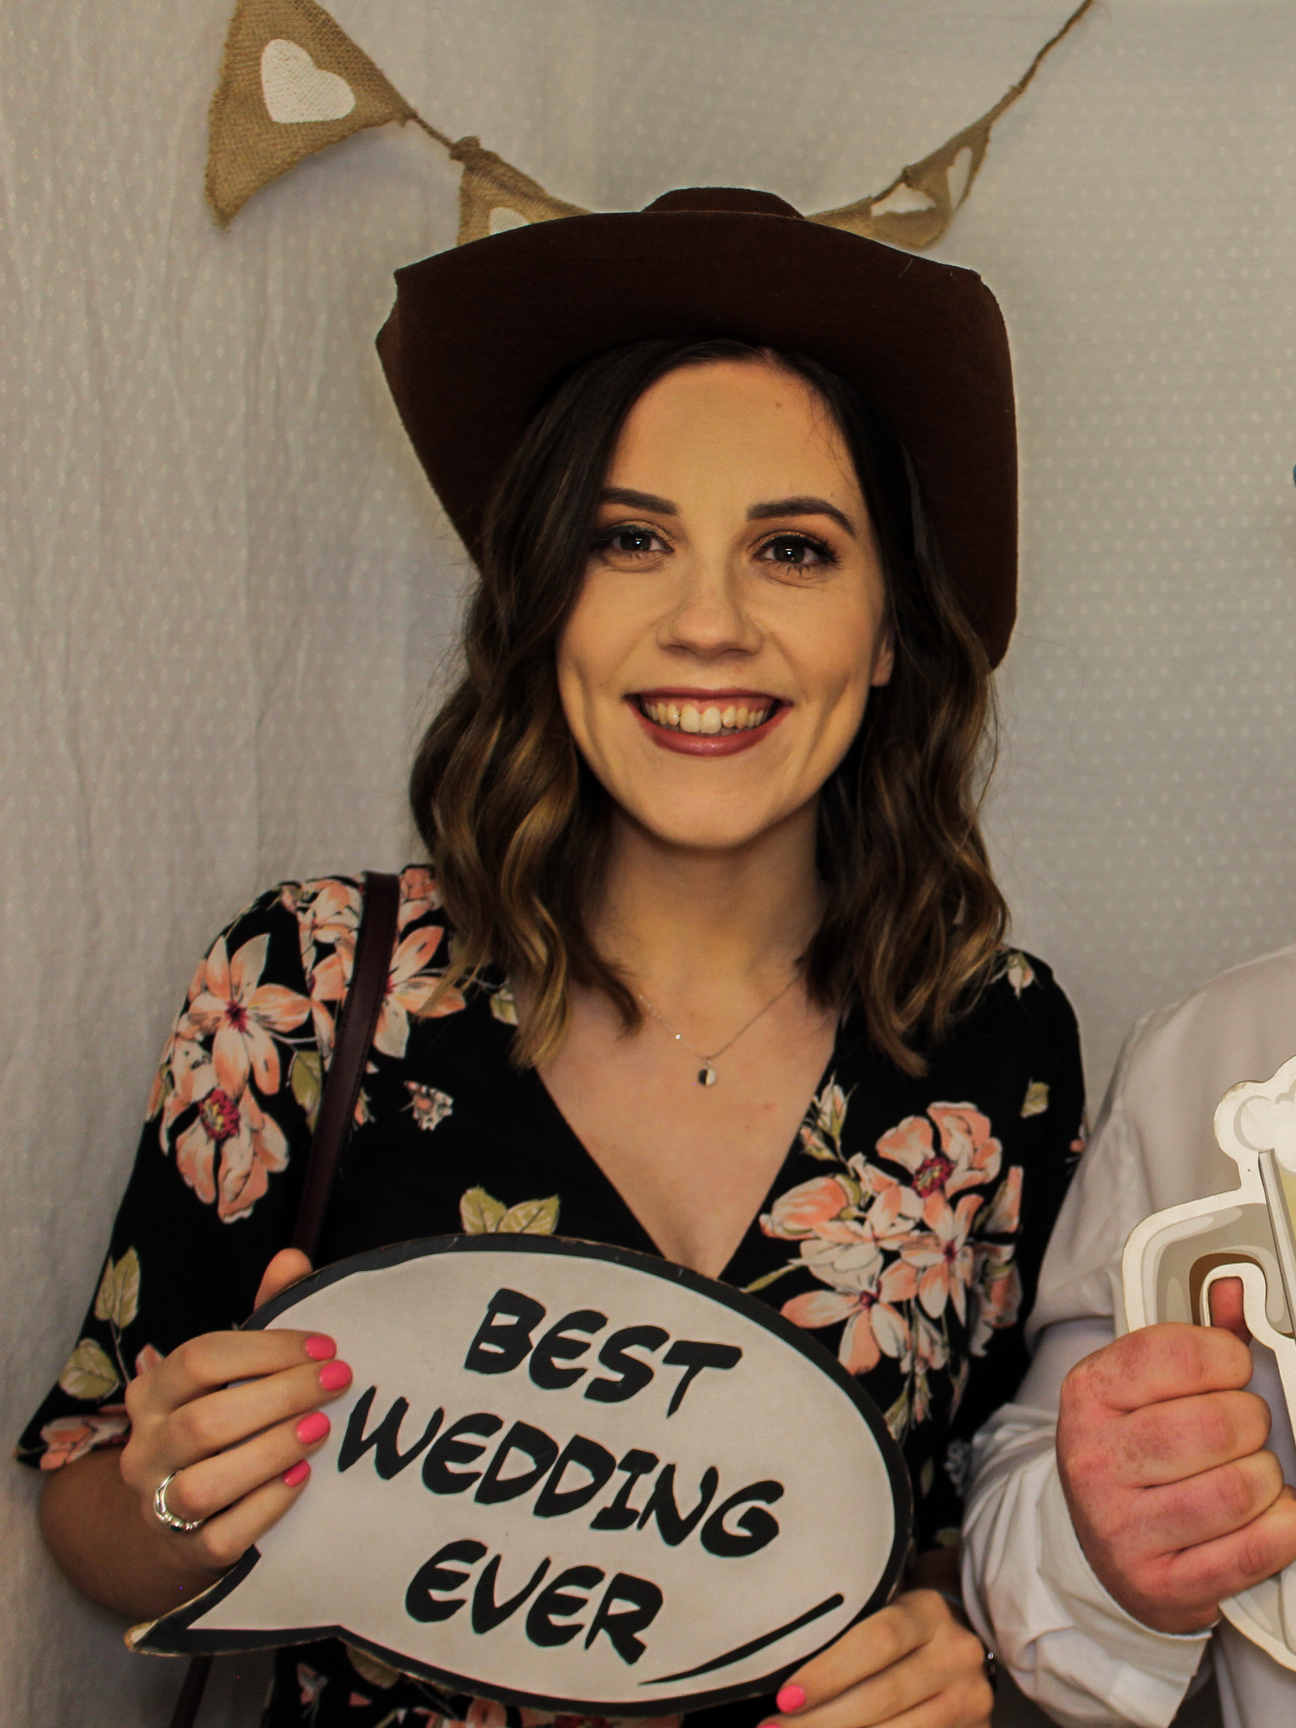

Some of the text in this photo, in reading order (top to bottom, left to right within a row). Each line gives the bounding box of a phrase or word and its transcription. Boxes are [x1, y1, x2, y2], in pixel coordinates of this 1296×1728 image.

[465, 1288, 742, 1417] BEST
[338, 1386, 784, 1557] WEDDING
[406, 1540, 663, 1665] EVER
